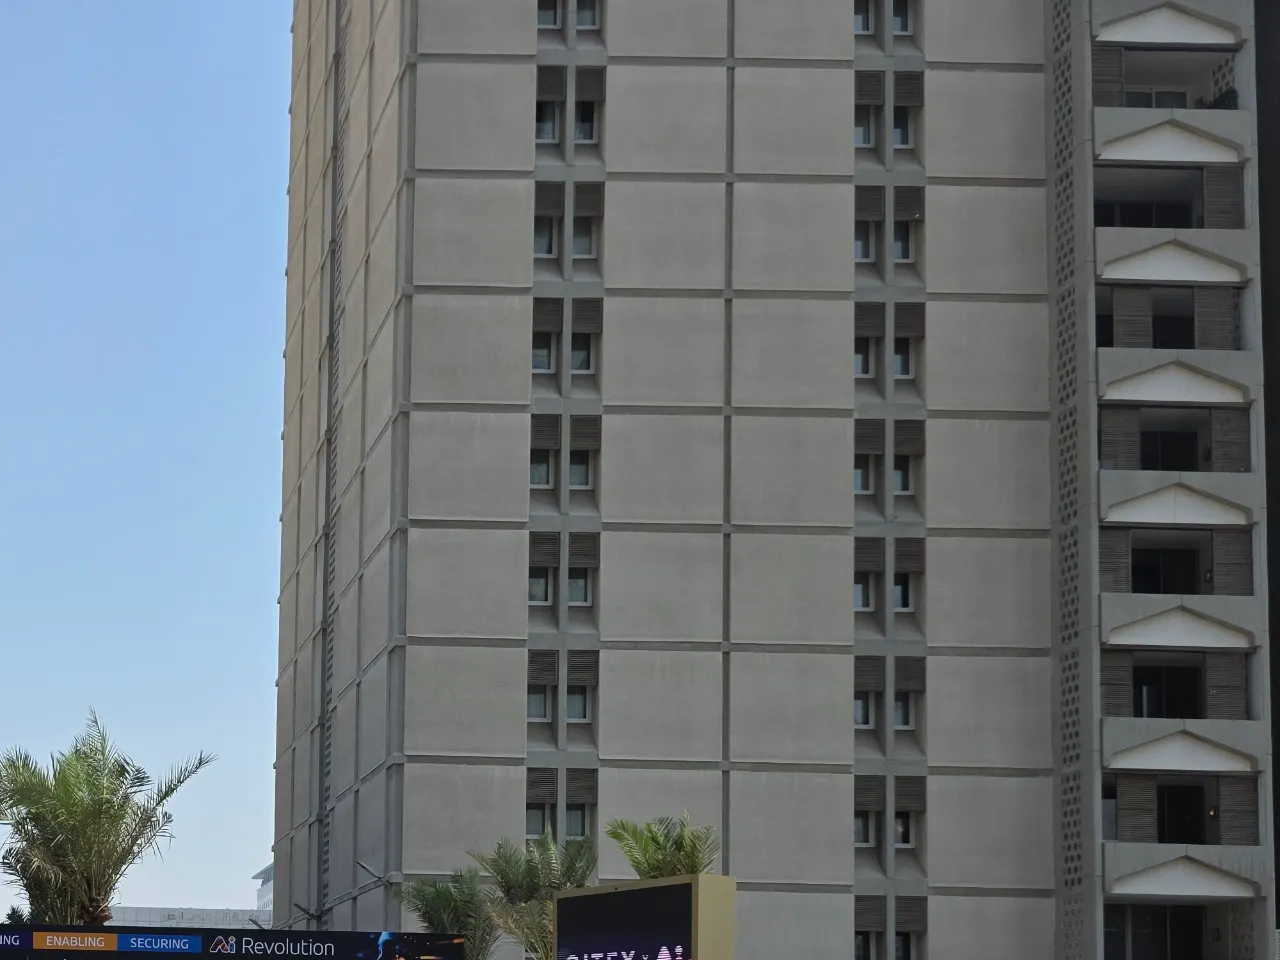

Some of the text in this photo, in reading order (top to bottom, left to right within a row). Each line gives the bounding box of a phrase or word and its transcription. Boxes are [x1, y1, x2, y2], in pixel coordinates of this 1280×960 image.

[46, 936, 105, 947] ENABLING
[130, 937, 189, 949] SECURING
[242, 937, 334, 956] Revolution
